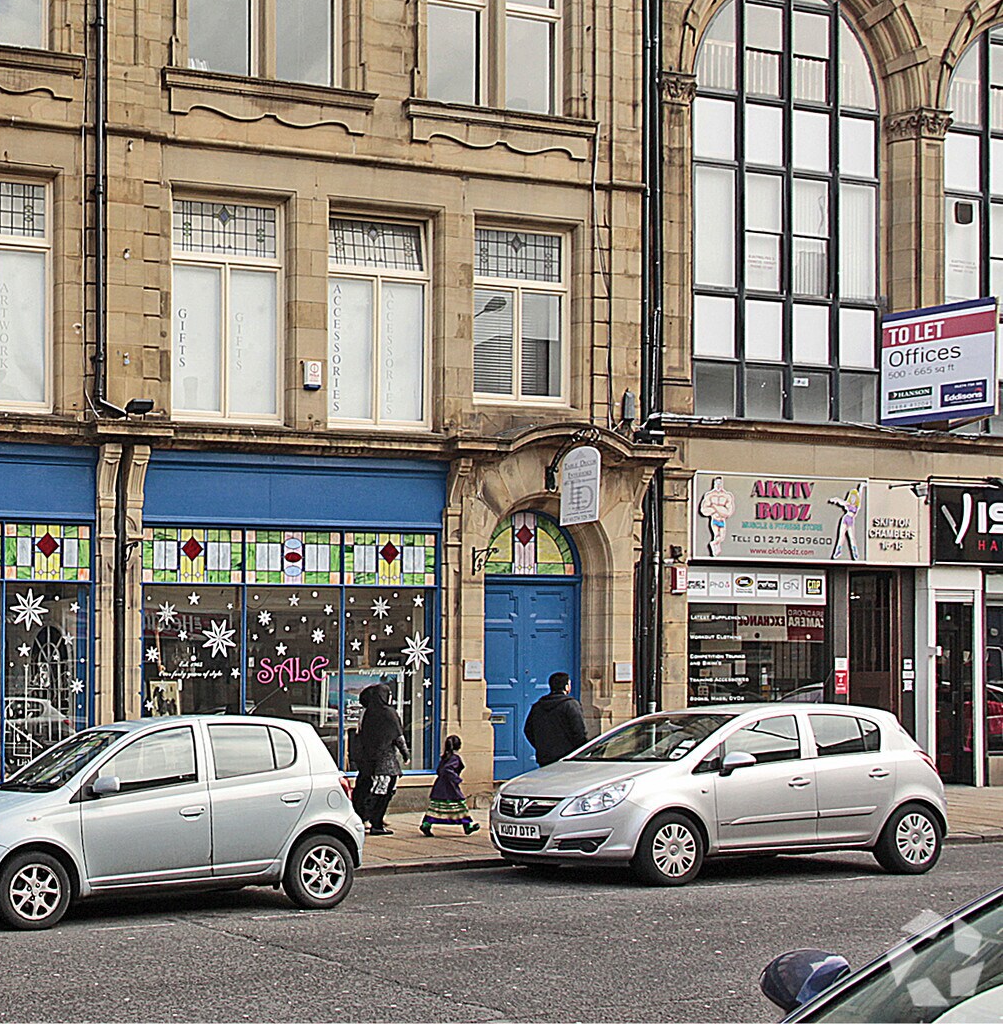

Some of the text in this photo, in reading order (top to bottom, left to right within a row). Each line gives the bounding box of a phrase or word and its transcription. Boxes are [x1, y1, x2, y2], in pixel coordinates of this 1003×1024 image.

[0, 283, 10, 369] ARTWORK
[888, 321, 945, 345] TO LET
[178, 308, 187, 368] GIFTS
[235, 312, 244, 371] GIFTS
[332, 284, 341, 412] ACCESSORIES
[385, 290, 394, 415] ACCESSORIES
[889, 345, 961, 368] Offices
[888, 370, 906, 380] 500
[914, 367, 932, 376] 665
[935, 365, 945, 373] sq
[898, 388, 930, 398] HANSON
[944, 392, 983, 402] Eddisons
[750, 480, 815, 499] AKTIV
[755, 502, 812, 522] BODZ
[872, 518, 910, 528] SKIPTON
[753, 535, 788, 544] 01274
[792, 536, 833, 545] 309600
[868, 529, 916, 540] CHAMBERS
[750, 547, 815, 556] www.aktivbodz.com
[257, 655, 330, 688] SALE
[519, 826, 536, 837] DTP
